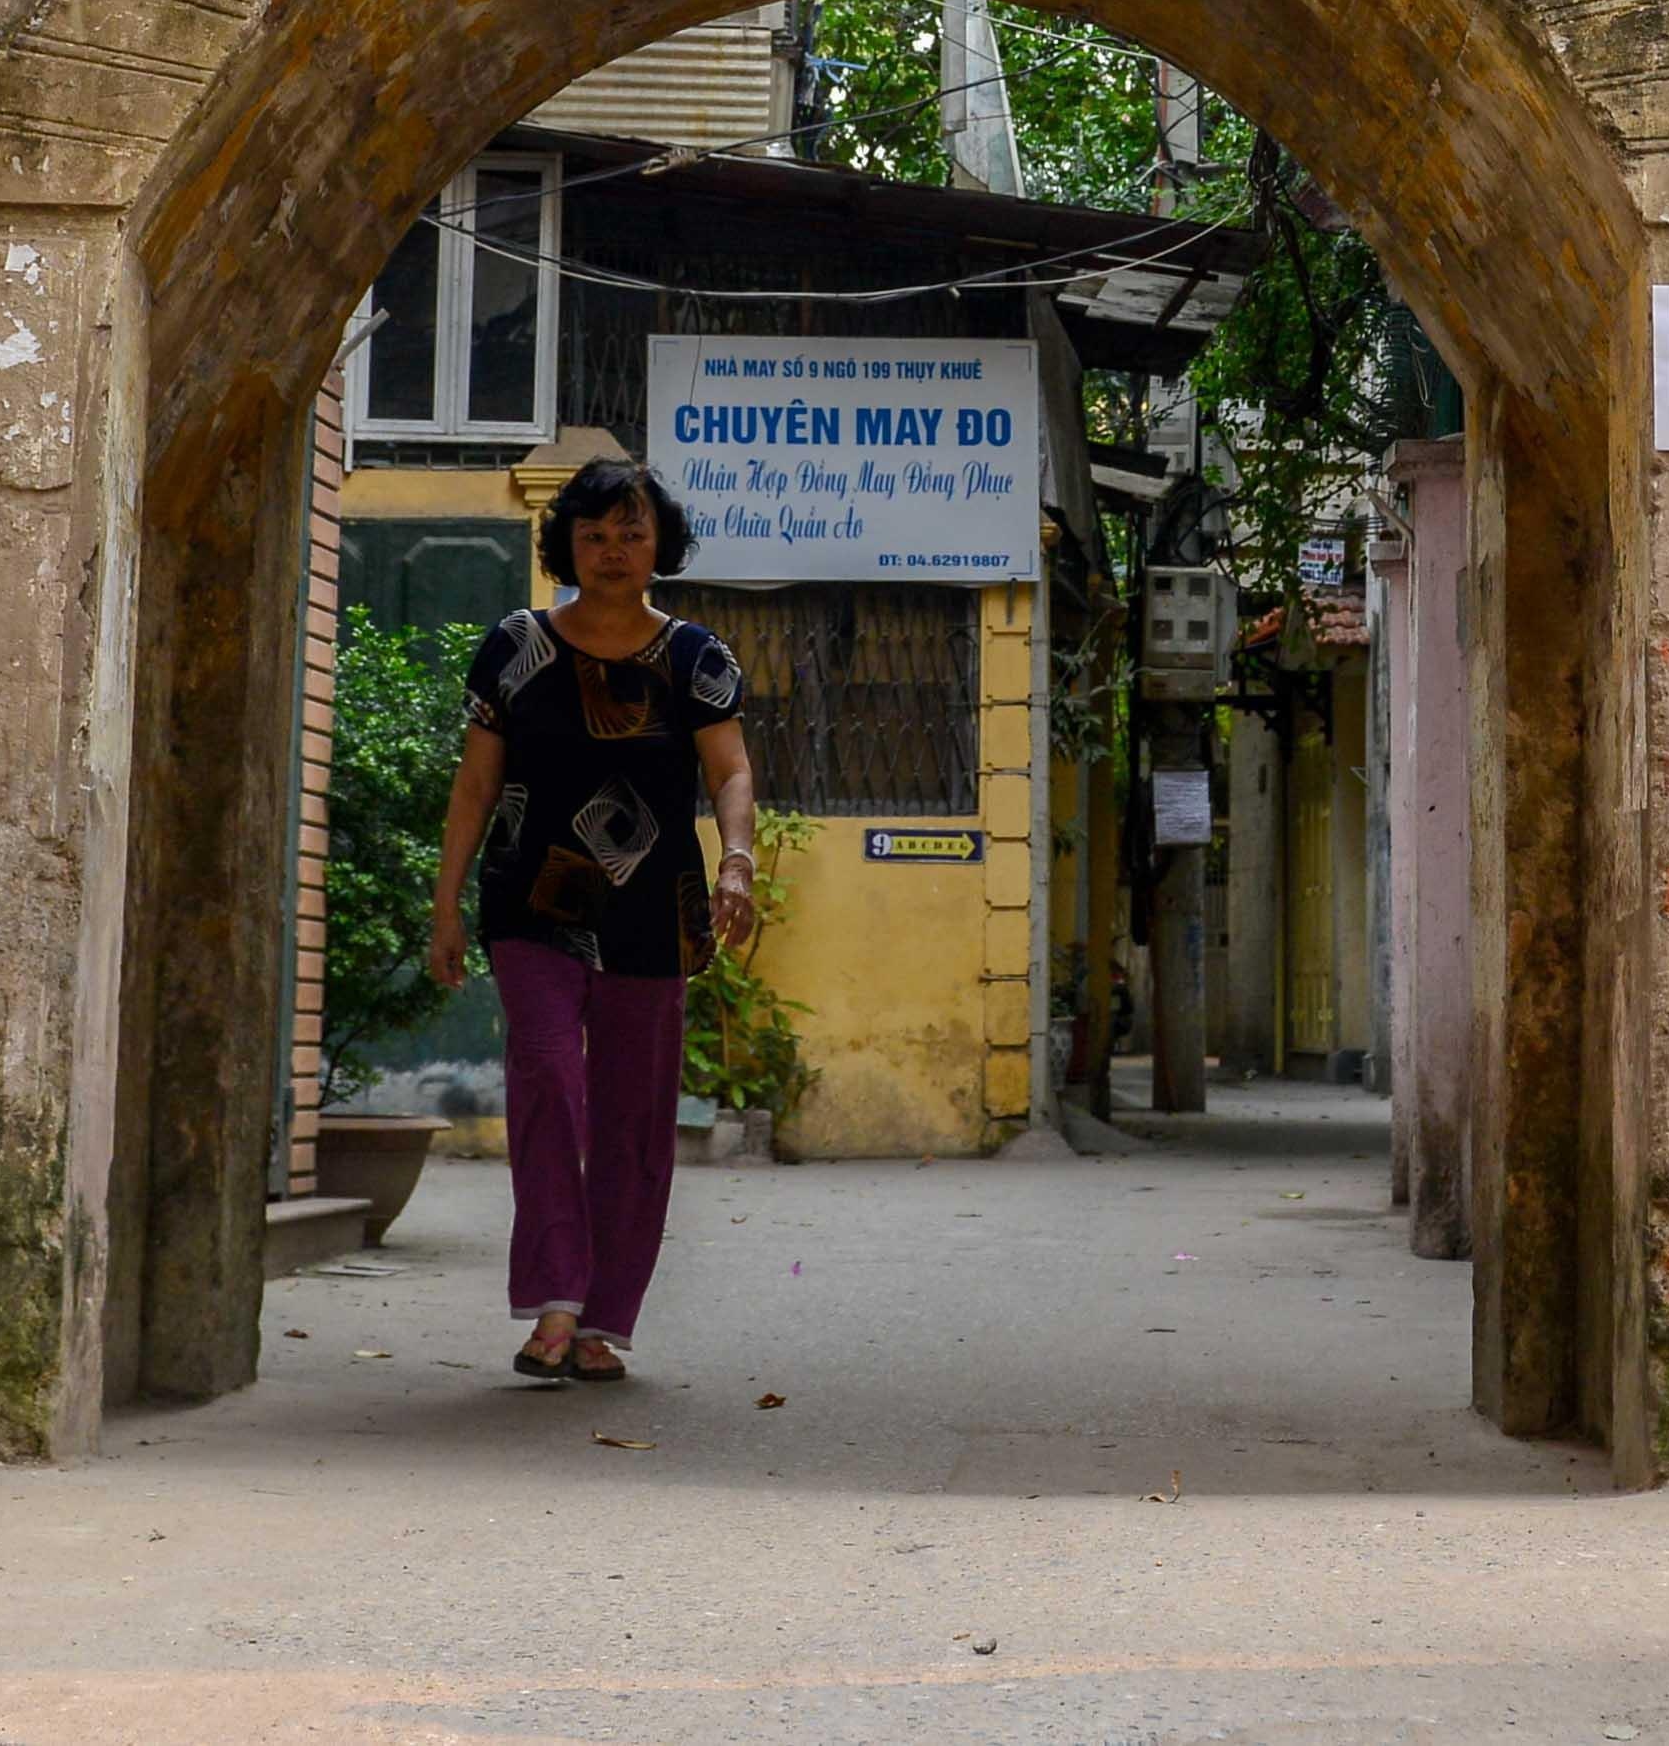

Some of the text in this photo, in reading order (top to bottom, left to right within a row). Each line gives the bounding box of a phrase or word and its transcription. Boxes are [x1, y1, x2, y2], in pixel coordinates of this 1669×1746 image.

[704, 354, 738, 377] NHÀ
[742, 360, 778, 378] MAY
[781, 353, 804, 377] SỐ
[808, 361, 818, 377] 9
[861, 361, 891, 379] 199
[895, 361, 934, 385] THỤY
[939, 355, 983, 381] KHUÊ
[674, 399, 1012, 447] CHUYÊN MAY ĐO
[682, 457, 1013, 503] Nhận Hợp Đồng May Đồng Phục
[723, 504, 772, 539] Chữa
[778, 505, 828, 546] Quần
[832, 499, 864, 541] Áo
[878, 554, 1011, 568] ĐT: 04.62919807
[871, 833, 892, 857] 9
